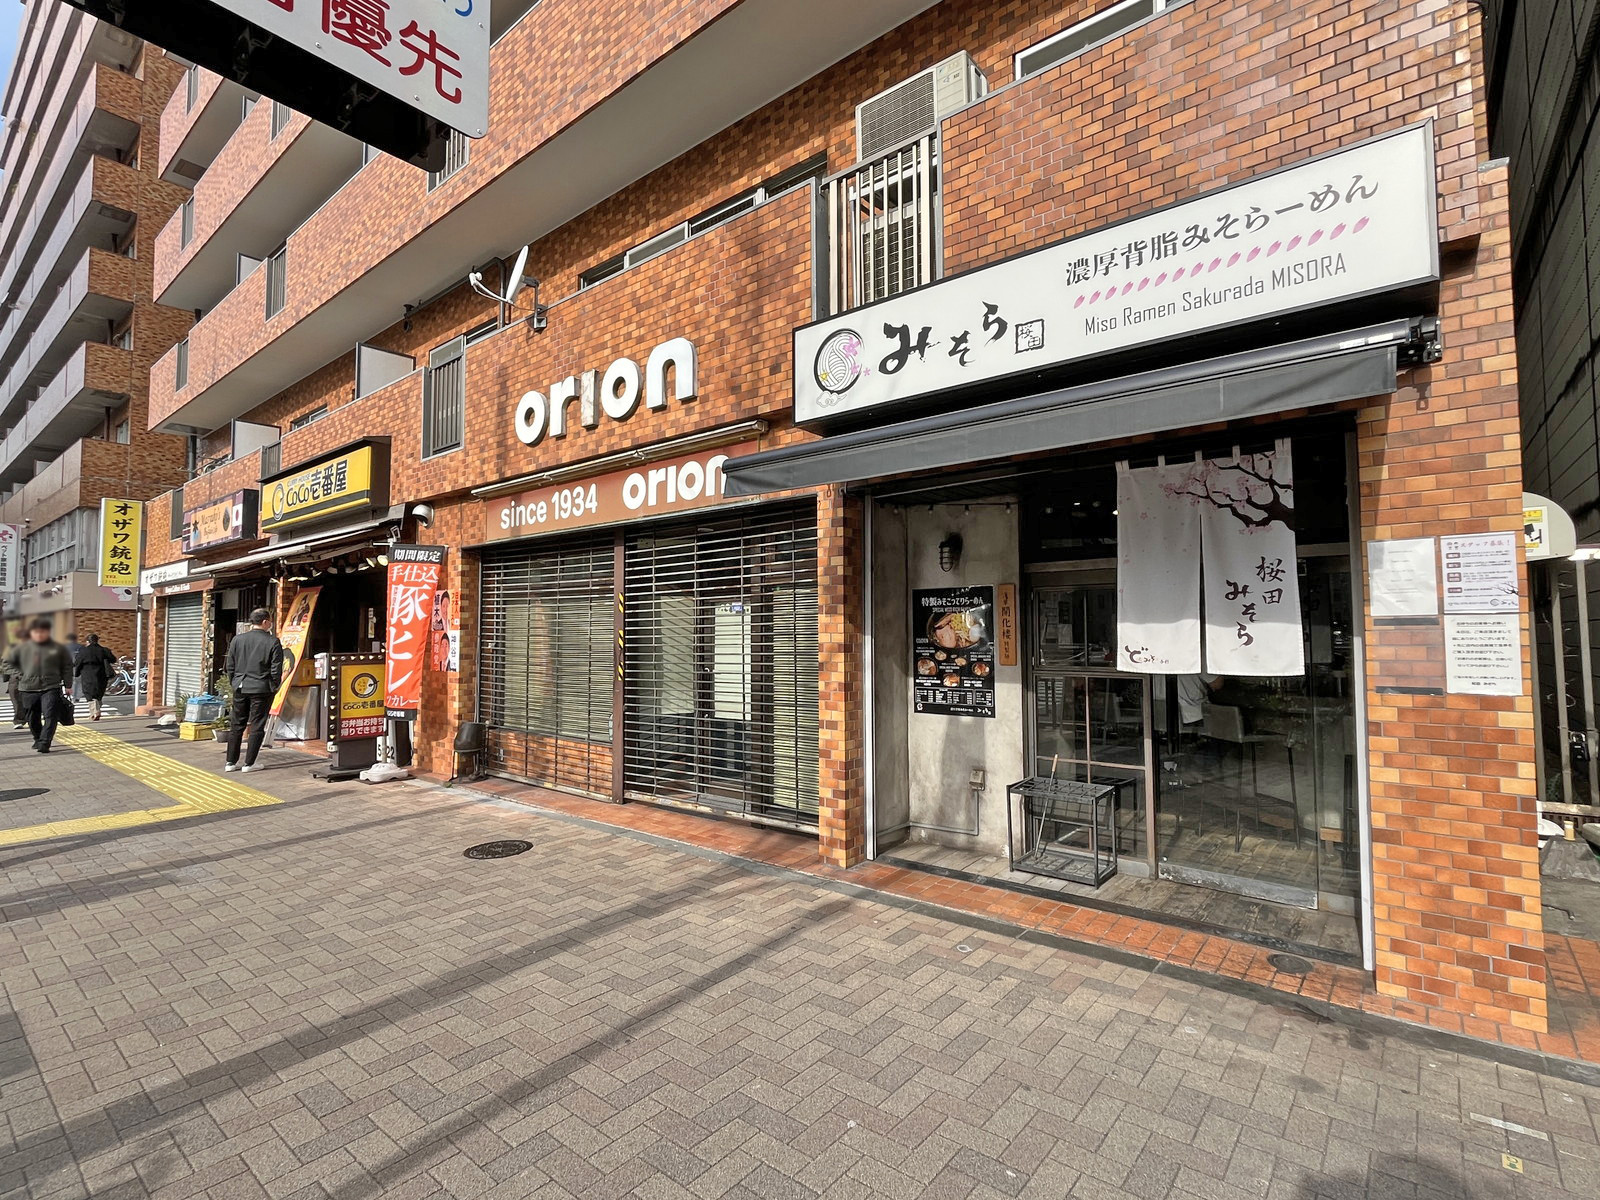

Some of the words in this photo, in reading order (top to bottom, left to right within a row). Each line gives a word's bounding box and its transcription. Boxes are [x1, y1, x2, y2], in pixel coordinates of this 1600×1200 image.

[265, 0, 463, 104] 優先
[1065, 174, 1379, 287] 濃厚背脂みそらーめん
[1084, 316, 1117, 336] Miso
[1123, 300, 1176, 327] Ramen
[1182, 275, 1265, 313] Sakurada
[1271, 252, 1347, 292] MISORA
[878, 300, 1009, 376] みそら
[514, 336, 698, 446] orion
[286, 459, 348, 508] CoCo壱番屋
[500, 500, 547, 530] since
[551, 483, 598, 521] 1934
[622, 454, 730, 510] orion
[108, 502, 135, 576] オザワ銃砲
[390, 564, 440, 584] 手仕込
[393, 549, 442, 562] 期間限定
[1224, 579, 1257, 652] みそら
[1255, 556, 1286, 605] 桜田
[387, 583, 433, 694] 豚ヒレ
